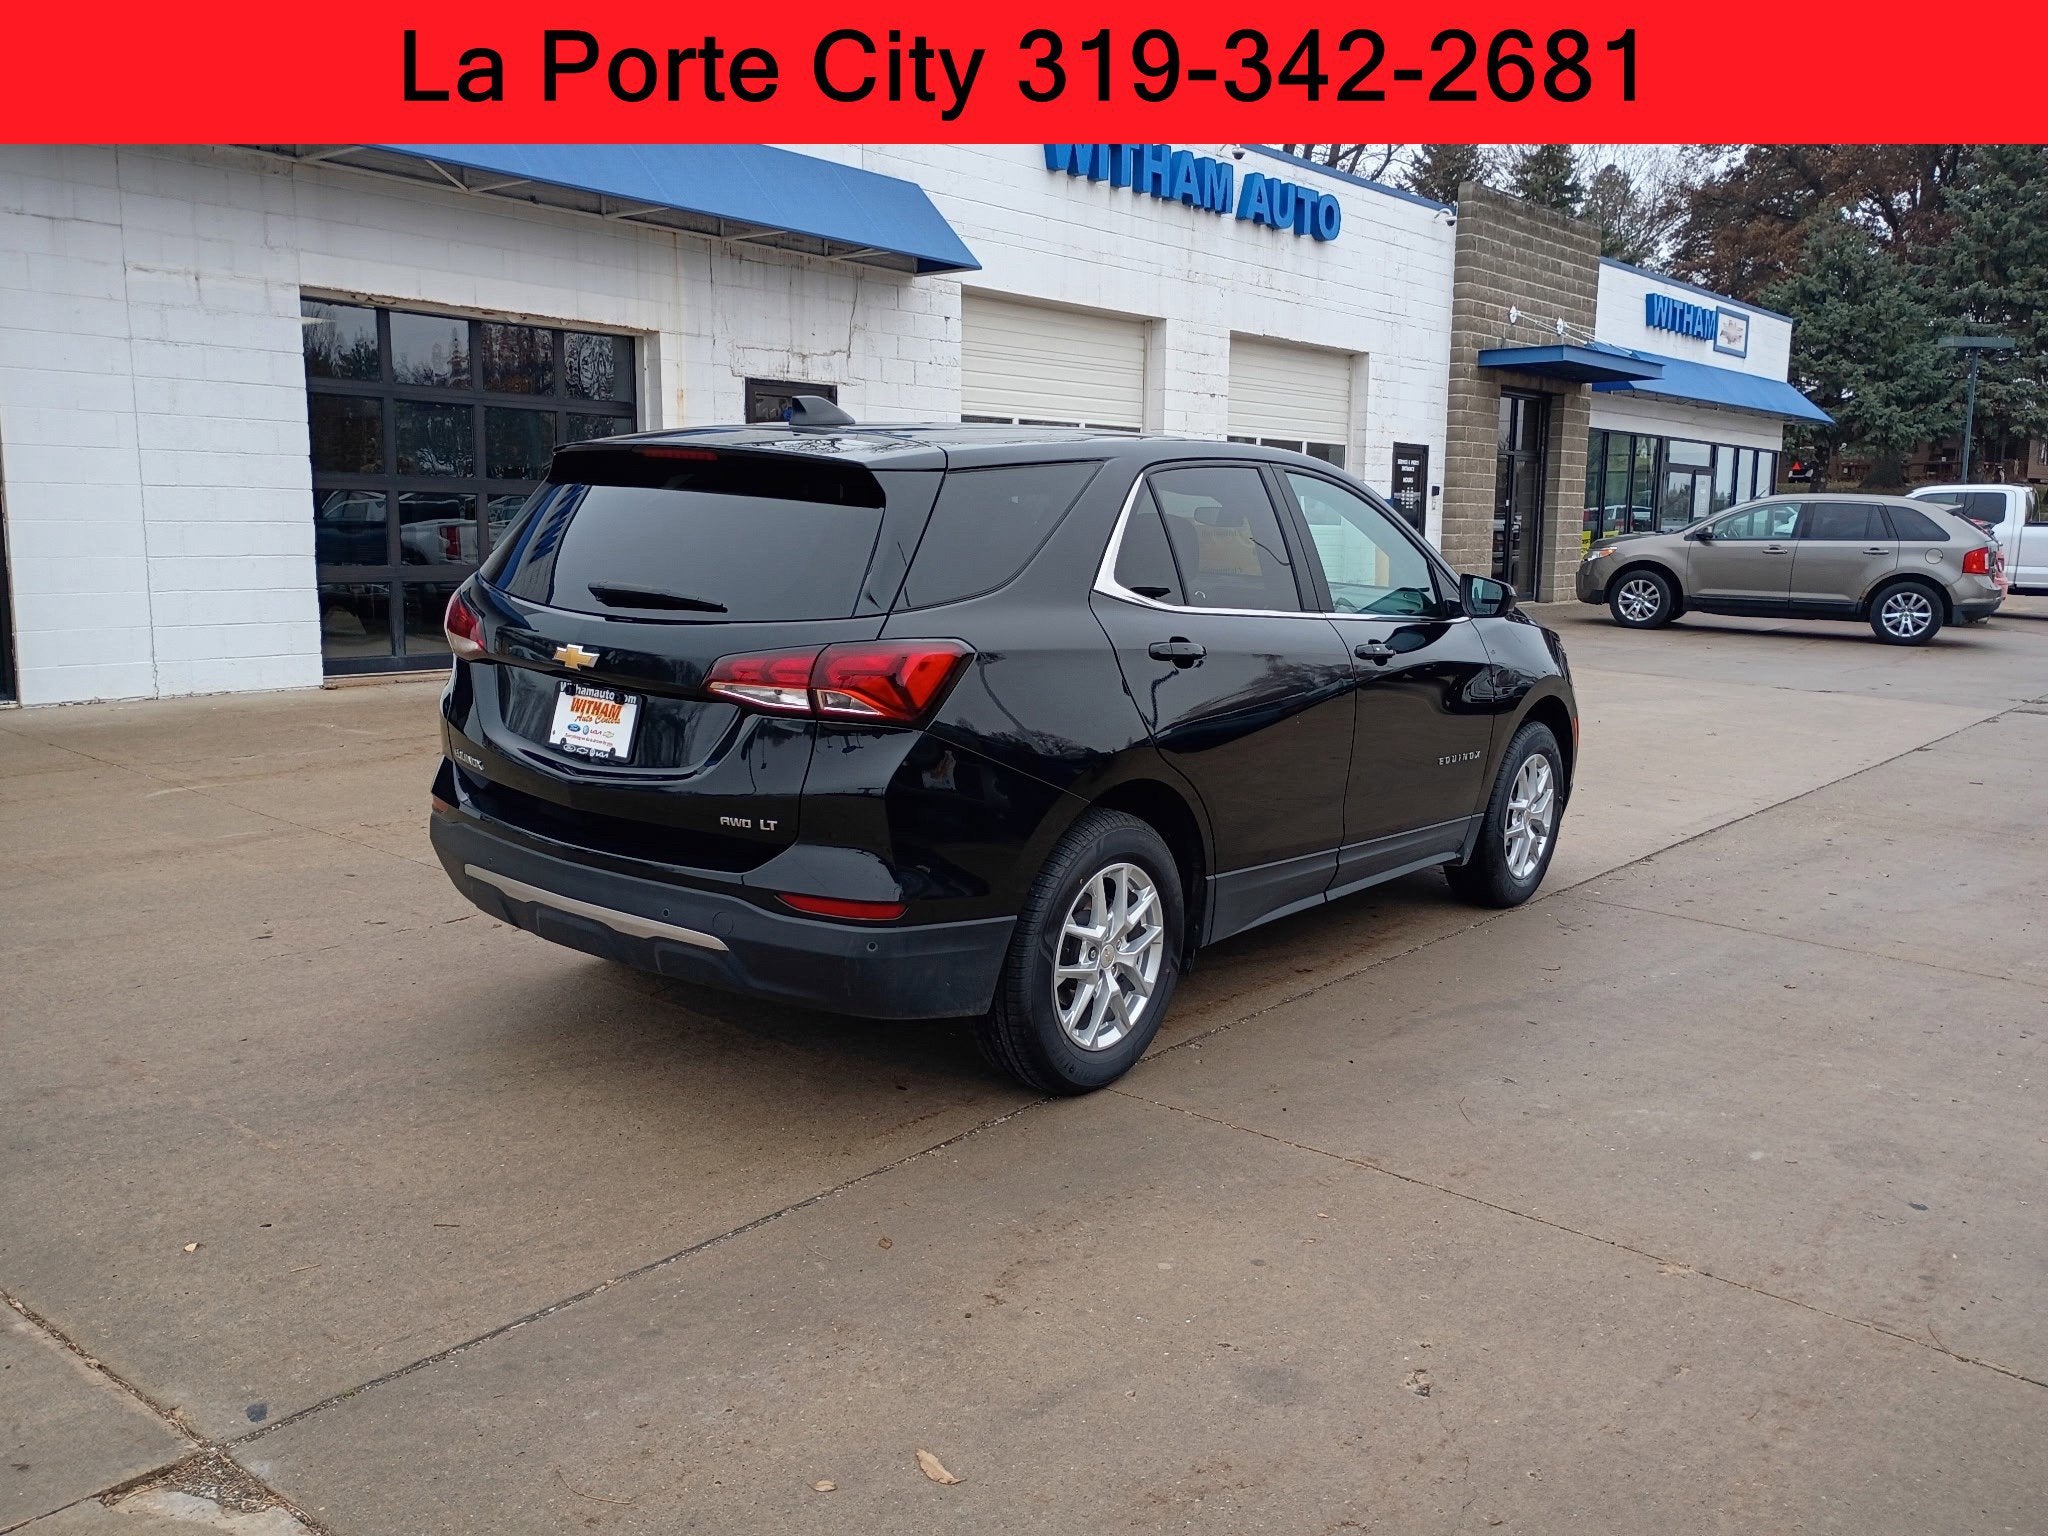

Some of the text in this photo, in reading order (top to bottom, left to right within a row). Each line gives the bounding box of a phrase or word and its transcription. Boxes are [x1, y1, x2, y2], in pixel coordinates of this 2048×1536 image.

[1235, 172, 1341, 242] AUTO
[1646, 293, 1717, 340] WITHAM
[571, 697, 622, 720] WITHAM
[720, 816, 778, 831] AWD LT
